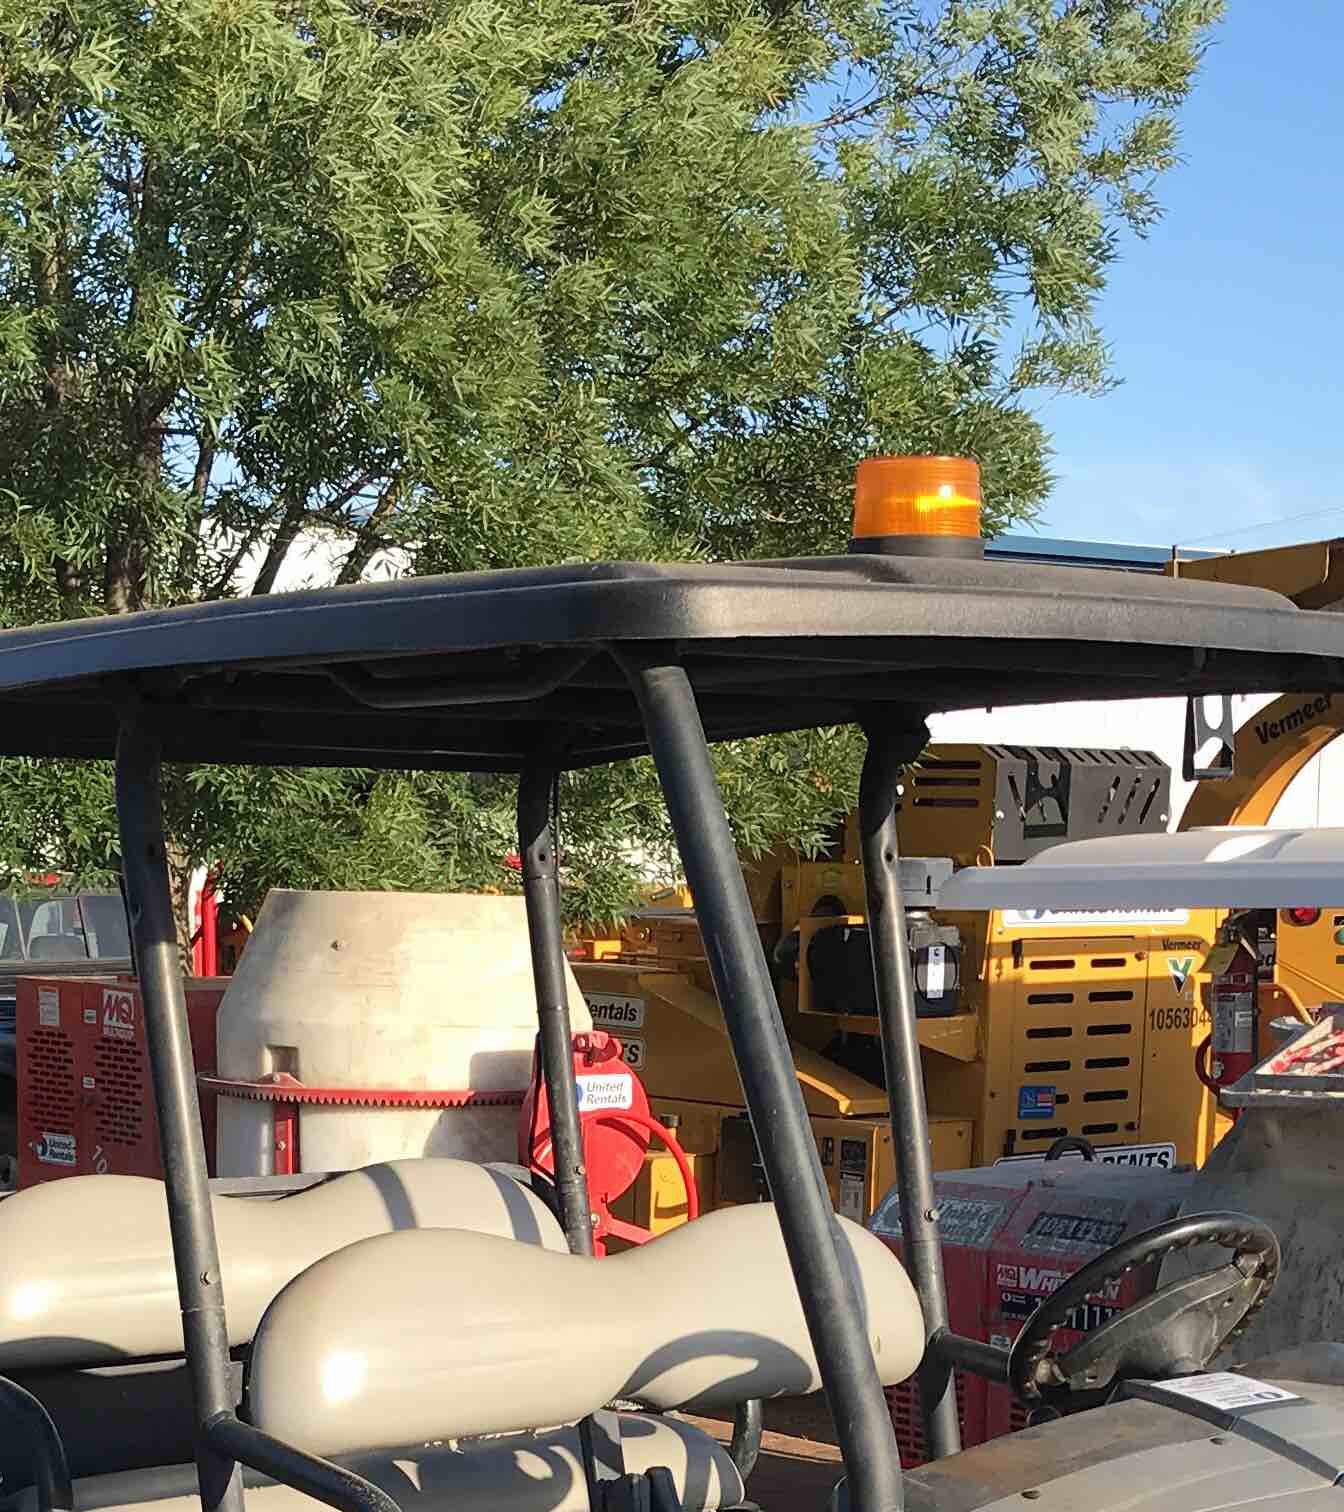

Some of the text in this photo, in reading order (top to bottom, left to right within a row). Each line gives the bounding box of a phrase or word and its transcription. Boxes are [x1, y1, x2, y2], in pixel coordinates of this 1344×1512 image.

[1255, 693, 1331, 744] Vermeer
[1162, 938, 1201, 950] Vermeer
[587, 1000, 638, 1021] entals
[586, 1081, 624, 1093] United
[586, 1093, 627, 1105] Rentals
